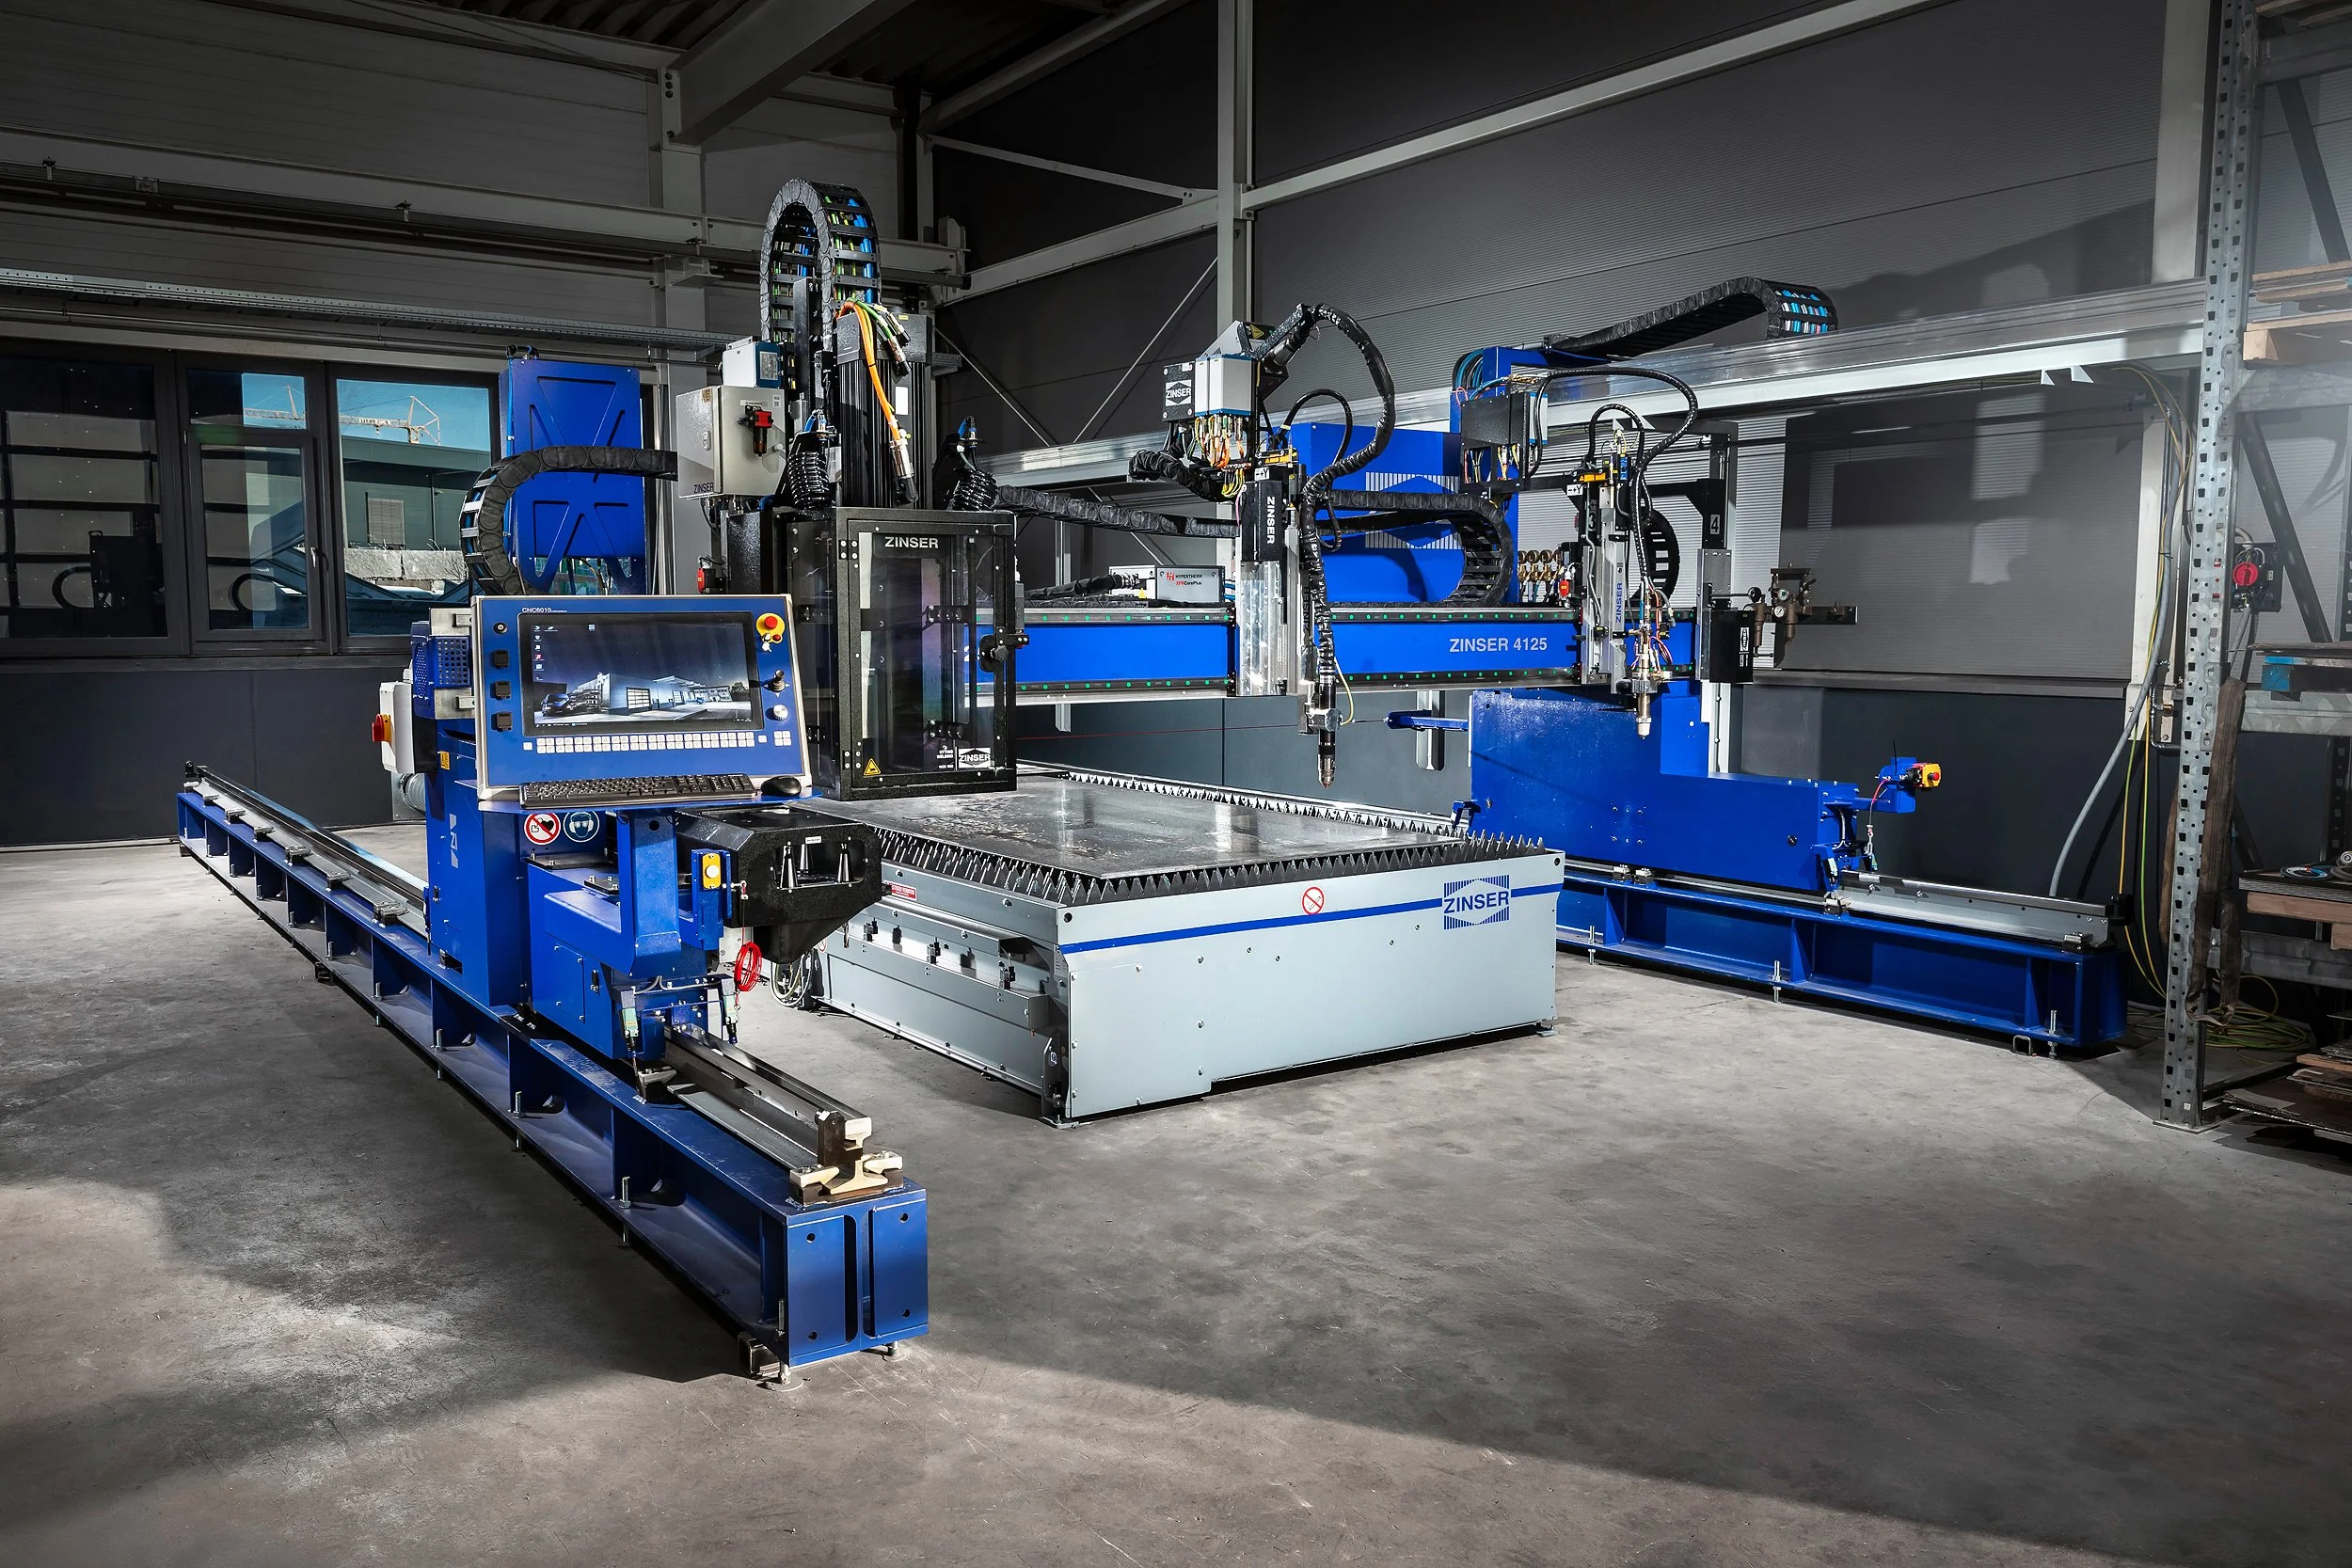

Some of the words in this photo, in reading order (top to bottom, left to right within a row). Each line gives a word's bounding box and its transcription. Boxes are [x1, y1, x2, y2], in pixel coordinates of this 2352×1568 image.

[1166, 388, 1191, 398] ZINSER
[693, 483, 714, 493] ZINSER
[1266, 496, 1276, 544] ZINSER
[1710, 515, 1720, 533] 4
[884, 536, 939, 549] ZINSER
[1449, 638, 1509, 653] ZINSER
[1513, 638, 1549, 651] 4125
[959, 753, 991, 763] ZINSER
[1443, 890, 1510, 914] ZINSER
